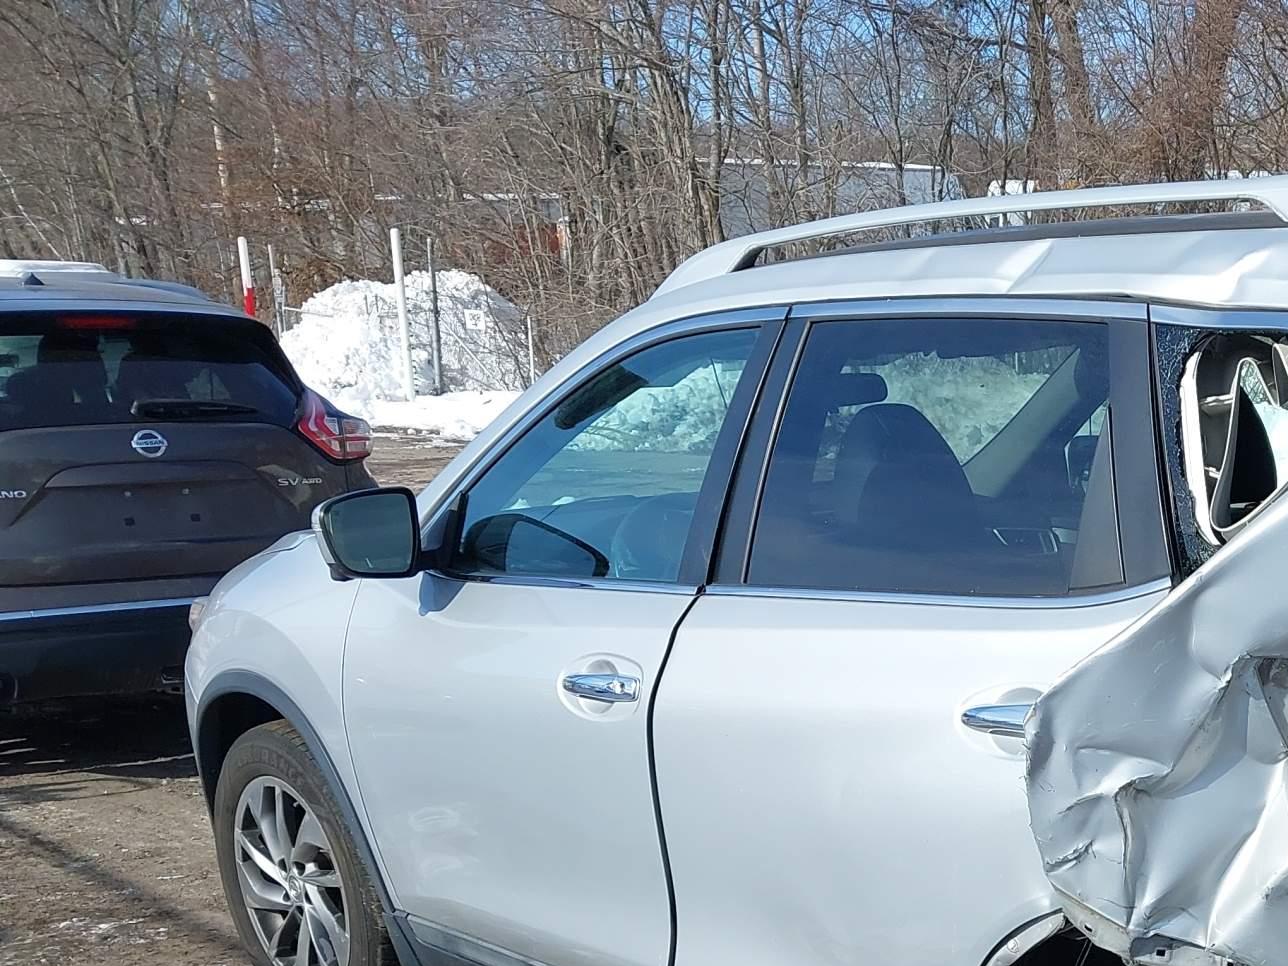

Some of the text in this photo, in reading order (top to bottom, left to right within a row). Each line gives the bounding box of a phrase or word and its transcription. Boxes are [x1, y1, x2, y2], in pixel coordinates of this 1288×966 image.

[135, 438, 166, 447] NISSAN
[278, 477, 299, 486] SV
[0, 491, 27, 500] NO
